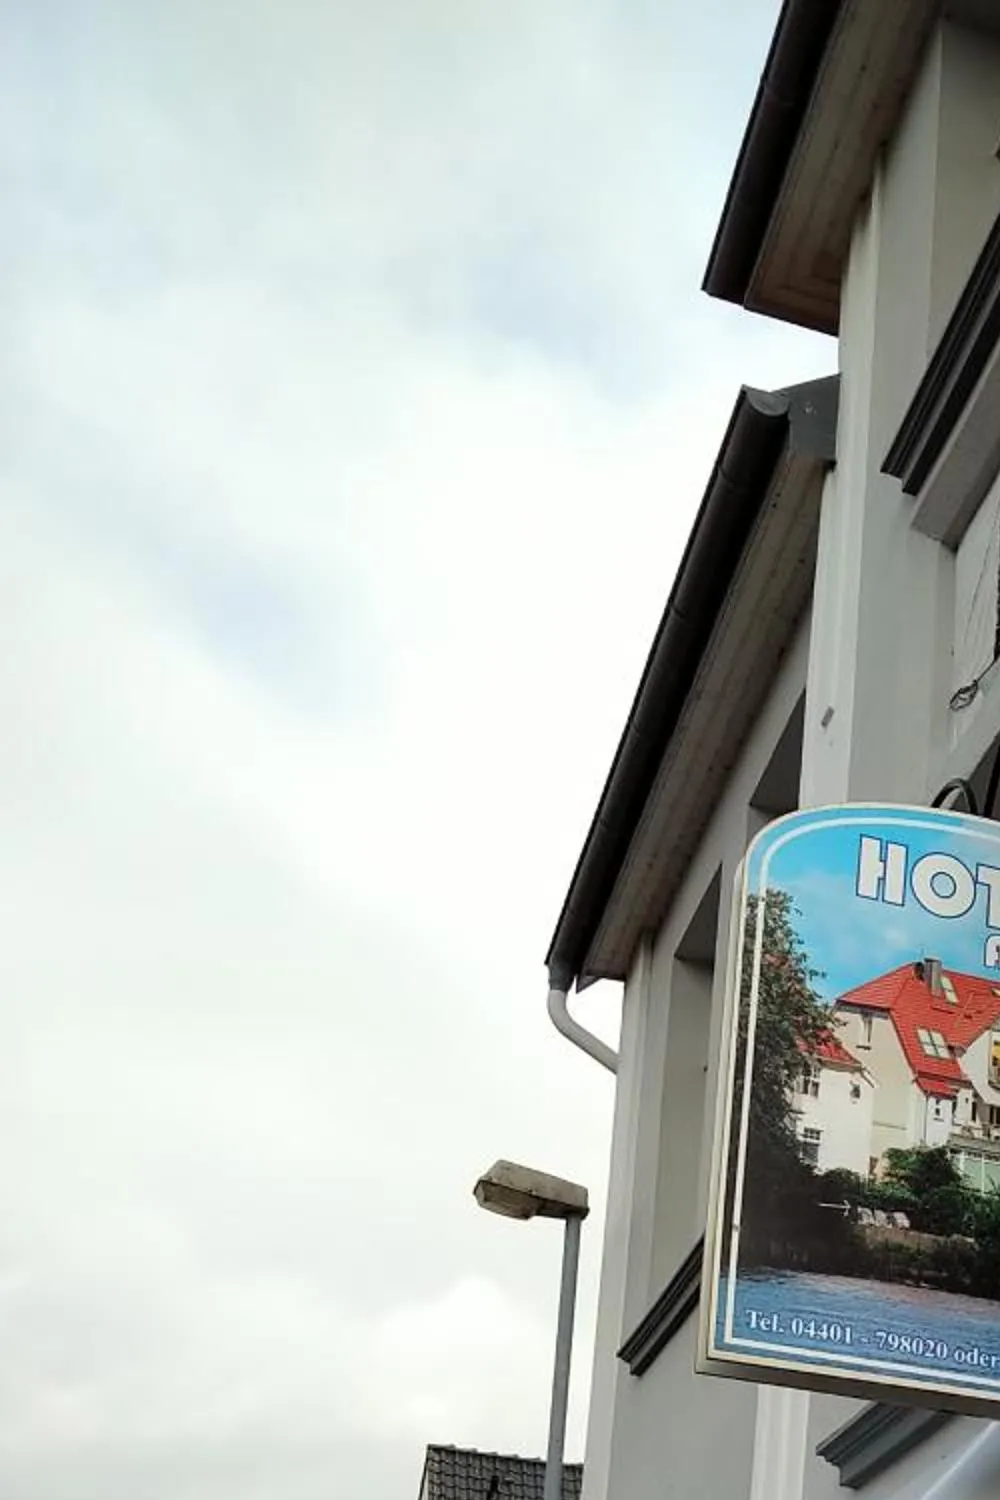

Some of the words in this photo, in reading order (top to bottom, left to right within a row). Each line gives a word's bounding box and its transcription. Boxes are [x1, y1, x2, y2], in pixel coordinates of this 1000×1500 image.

[746, 1309, 785, 1333] Tel.
[791, 1318, 852, 1345] 04401
[875, 1331, 948, 1359] 798020
[954, 1348, 1000, 1368] oder
